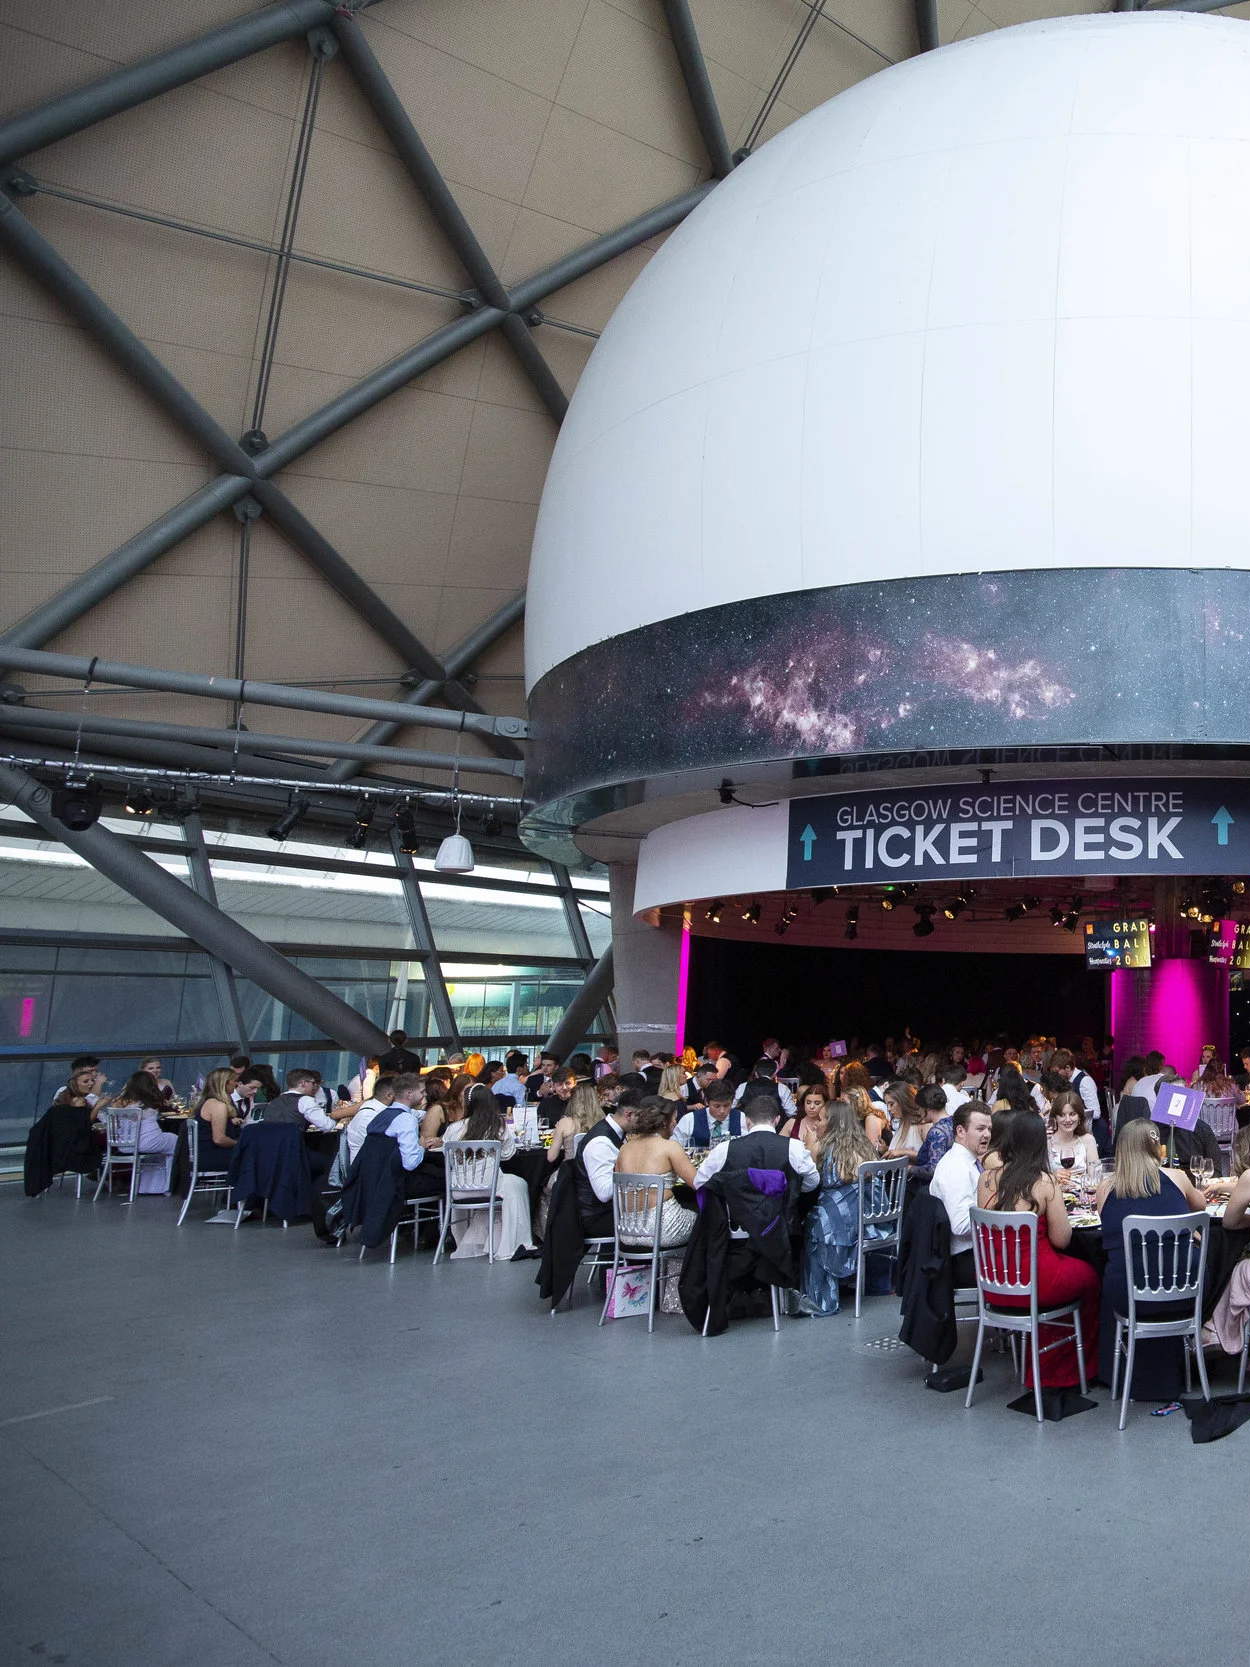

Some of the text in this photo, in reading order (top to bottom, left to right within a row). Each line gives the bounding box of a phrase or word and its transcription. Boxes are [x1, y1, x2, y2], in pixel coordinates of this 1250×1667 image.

[836, 791, 1184, 827] GLASGOW SCIENCE CENTRE
[836, 816, 1185, 871] TICKET DESK
[1113, 921, 1147, 933] GRAD
[1114, 938, 1147, 949] BALL
